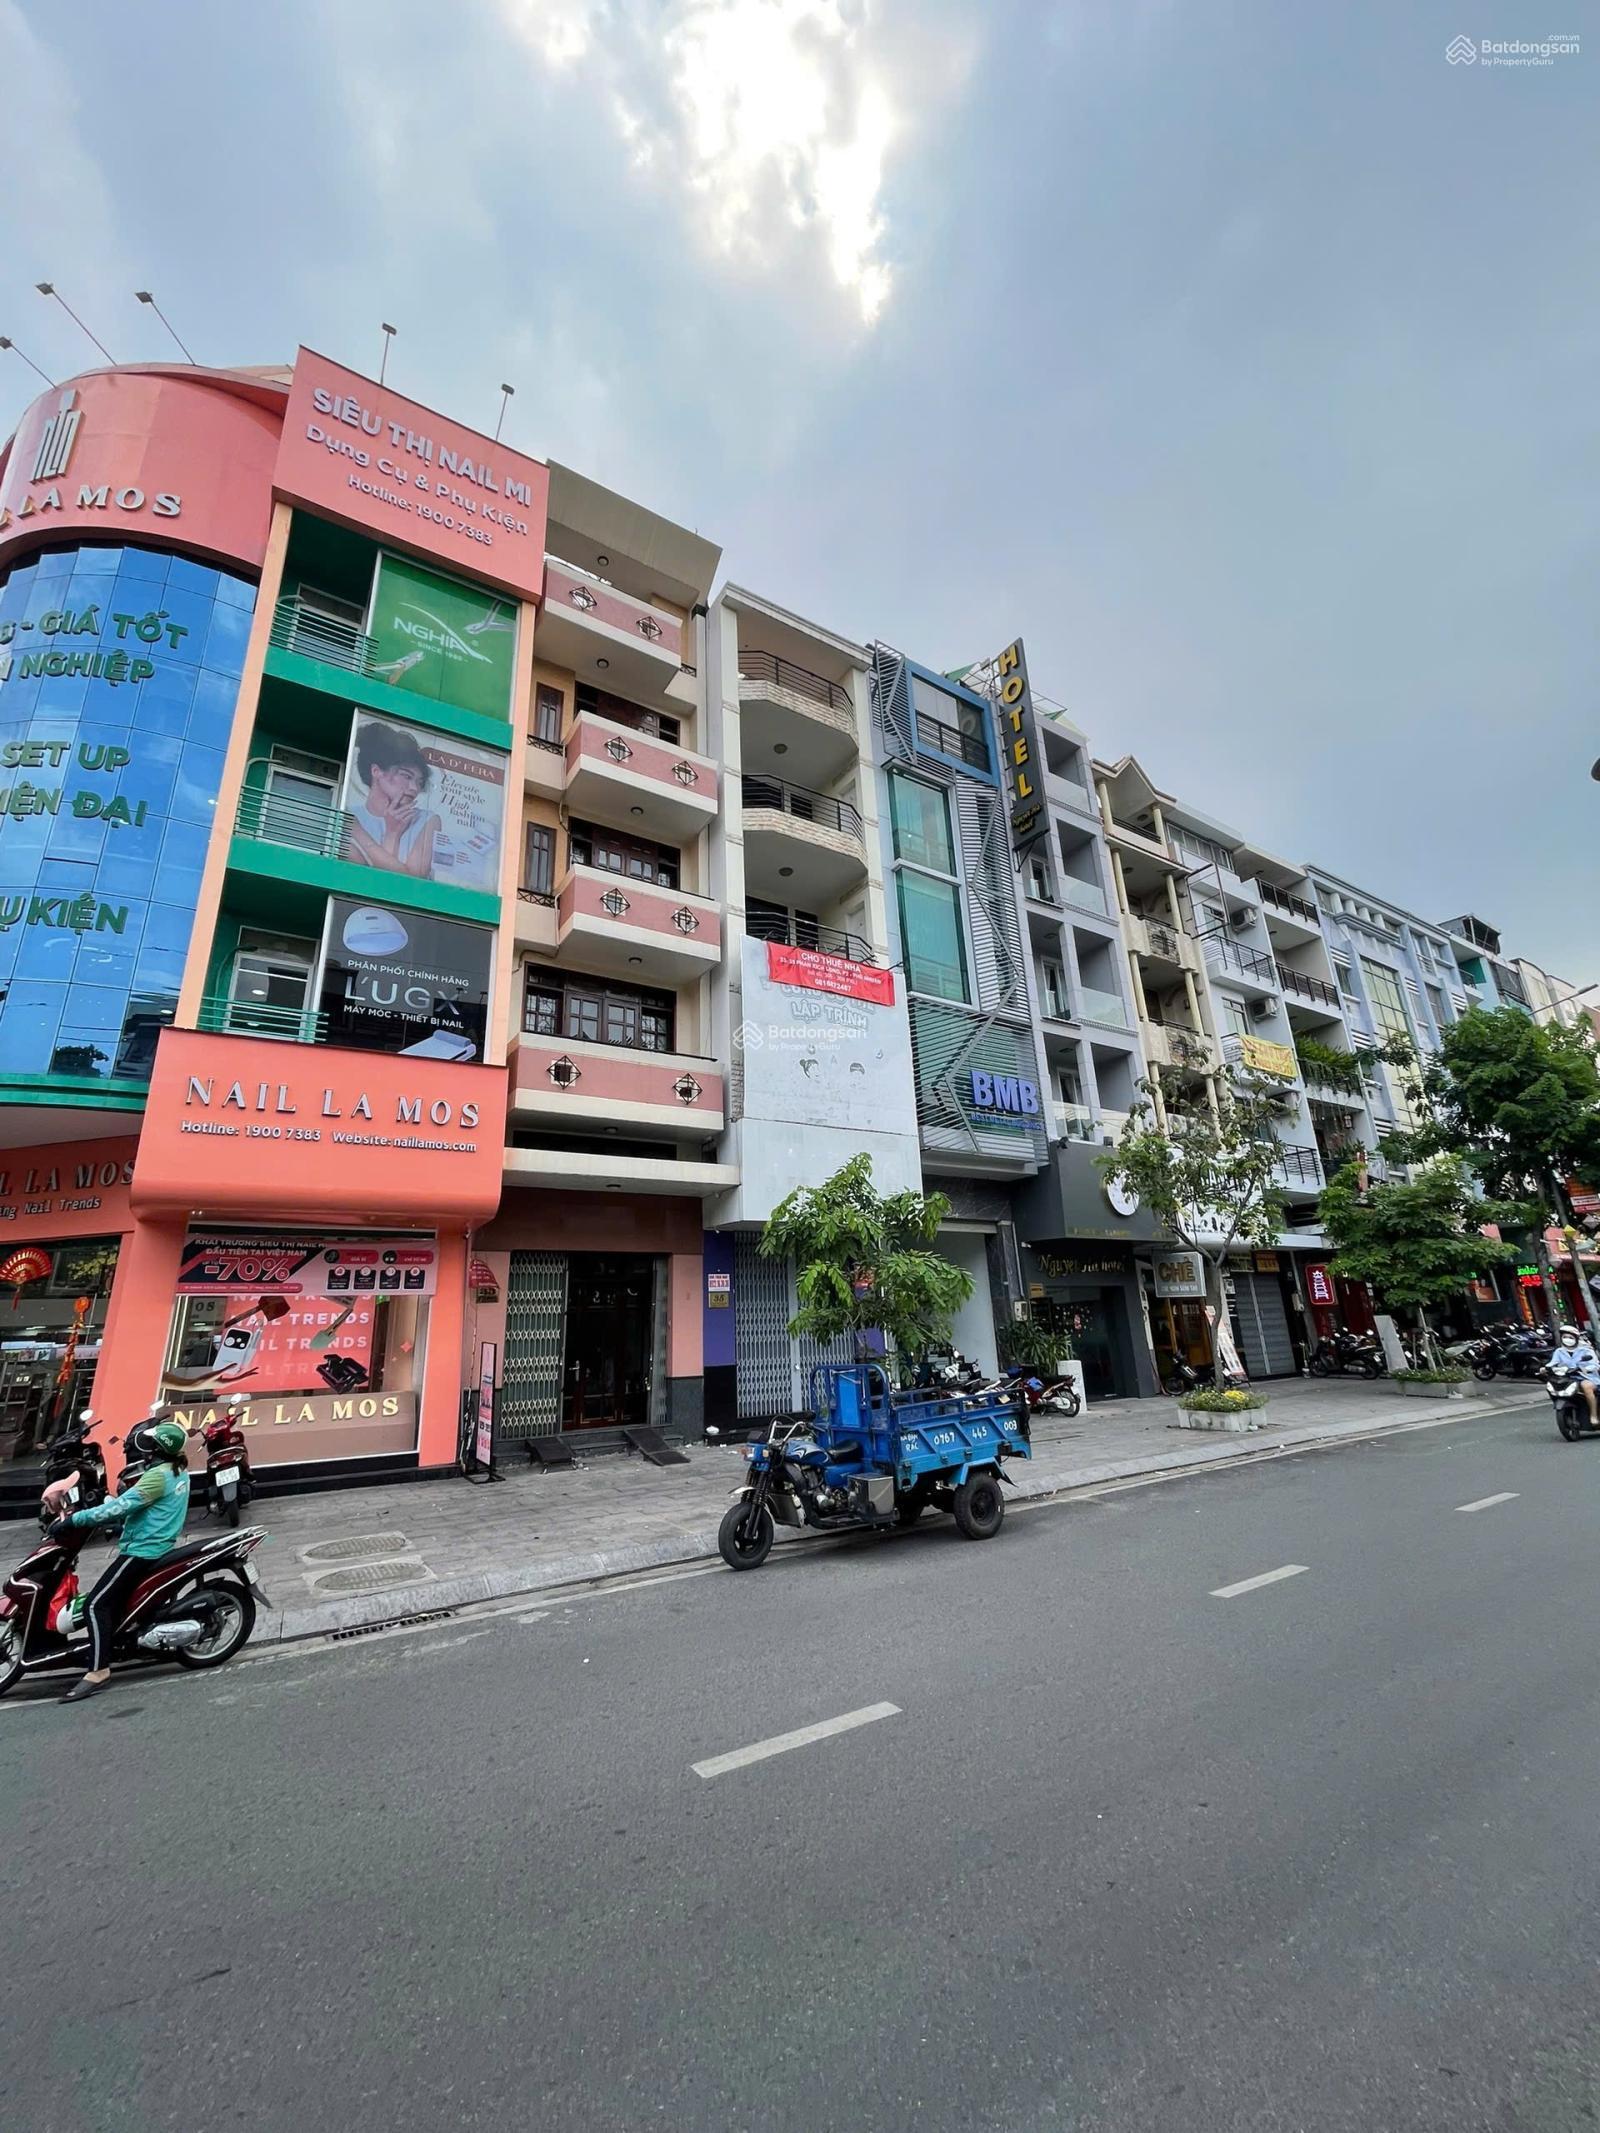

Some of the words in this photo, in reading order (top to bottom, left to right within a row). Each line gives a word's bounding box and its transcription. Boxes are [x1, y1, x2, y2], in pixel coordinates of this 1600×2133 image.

[313, 387, 382, 436] SIÊU
[388, 422, 434, 467] THỊ
[439, 446, 499, 493] NAIL
[504, 477, 532, 508] MI
[306, 424, 371, 468] Dụng
[377, 458, 409, 485] Cụ
[414, 474, 430, 491] &
[436, 483, 476, 516] Phụ
[481, 503, 529, 535] Kiện
[17, 486, 63, 520] LA
[75, 484, 182, 517] MOS
[348, 474, 413, 511] Hotline:
[416, 503, 455, 529] 1900
[458, 523, 493, 546] 7383
[39, 604, 100, 636] GIÁ
[112, 610, 189, 650] TỐT
[19, 649, 155, 687] NGHIỆP
[999, 644, 1033, 799] HOTEL
[0, 741, 71, 768] SET
[77, 743, 131, 772] UP
[440, 785, 461, 796] your
[463, 792, 486, 805] style
[441, 793, 470, 810] High
[72, 795, 148, 829] ĐẠI
[27, 893, 130, 935] KIỆN
[347, 959, 378, 972] PHÂN
[380, 964, 405, 976] PHỐI
[407, 969, 439, 982] CHÍNH
[440, 974, 469, 987] HÃNG
[801, 952, 819, 963] CHO
[820, 955, 843, 968] THUÊ
[343, 1004, 366, 1015] MÁY
[368, 1006, 392, 1018] MÓC
[400, 1011, 429, 1024] THIẾT
[430, 1017, 440, 1026] BỊ
[442, 1018, 465, 1029] NAIL
[185, 1075, 297, 1114] NAIL
[321, 1088, 374, 1119] LA
[396, 1095, 481, 1128] MOS
[971, 1070, 1039, 1114] BMB
[181, 1119, 240, 1137] Hotline:
[244, 1123, 282, 1140] 1900
[285, 1127, 322, 1142] 7383
[25, 1166, 60, 1194] LA
[75, 1160, 135, 1189] MOS
[24, 1200, 52, 1215] Nail
[60, 1195, 102, 1211] Trends
[204, 1256, 291, 1281] -70%
[287, 1250, 308, 1258] NAM
[290, 1312, 370, 1325] TRENDS
[286, 1337, 368, 1350] TRNDS
[274, 1403, 315, 1425] LA
[331, 1396, 400, 1421] MOS
[934, 1432, 955, 1445] 0767
[971, 1426, 988, 1439] 445
[1003, 1419, 1018, 1432] 003
